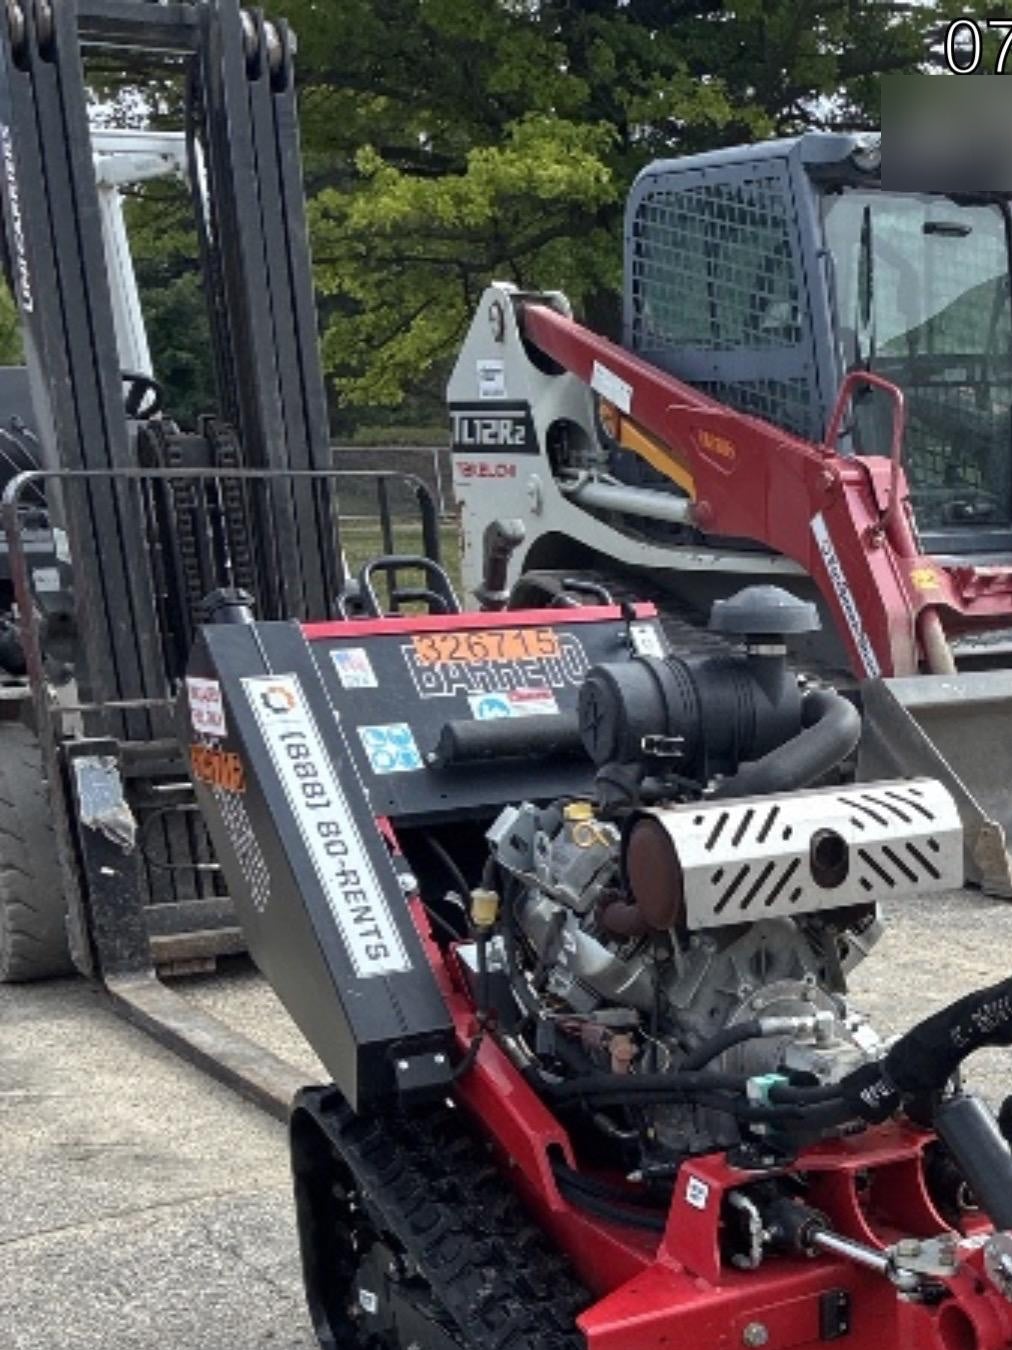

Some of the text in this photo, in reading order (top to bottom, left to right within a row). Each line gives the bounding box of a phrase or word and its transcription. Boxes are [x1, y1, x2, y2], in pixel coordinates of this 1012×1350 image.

[416, 630, 557, 664] 326715
[278, 731, 390, 962] (888) 80-RENTS
